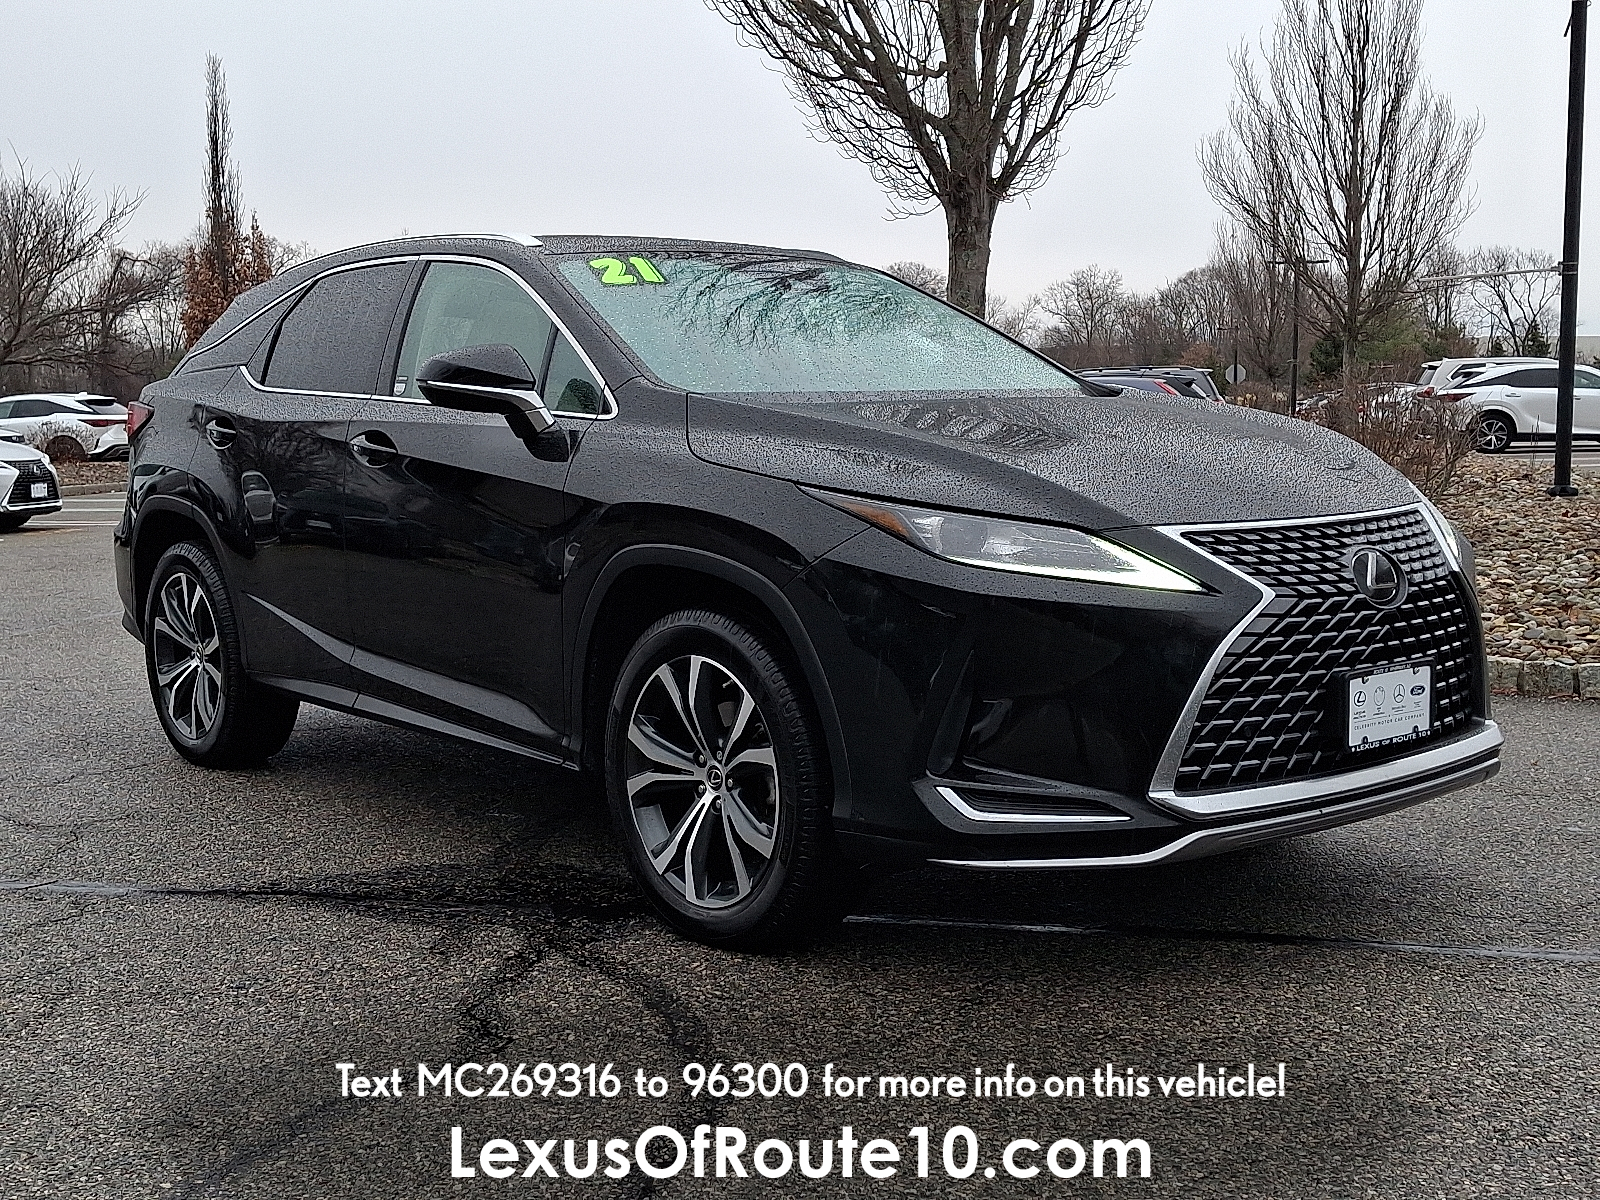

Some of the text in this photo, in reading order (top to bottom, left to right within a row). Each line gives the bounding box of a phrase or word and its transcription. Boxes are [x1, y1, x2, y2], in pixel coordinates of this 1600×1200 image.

[589, 256, 665, 284] 21
[1354, 722, 1376, 731] CELEBRITY
[1405, 712, 1425, 721] COMPANY
[1356, 741, 1380, 752] LEXUS
[1392, 732, 1417, 744] ROUTE
